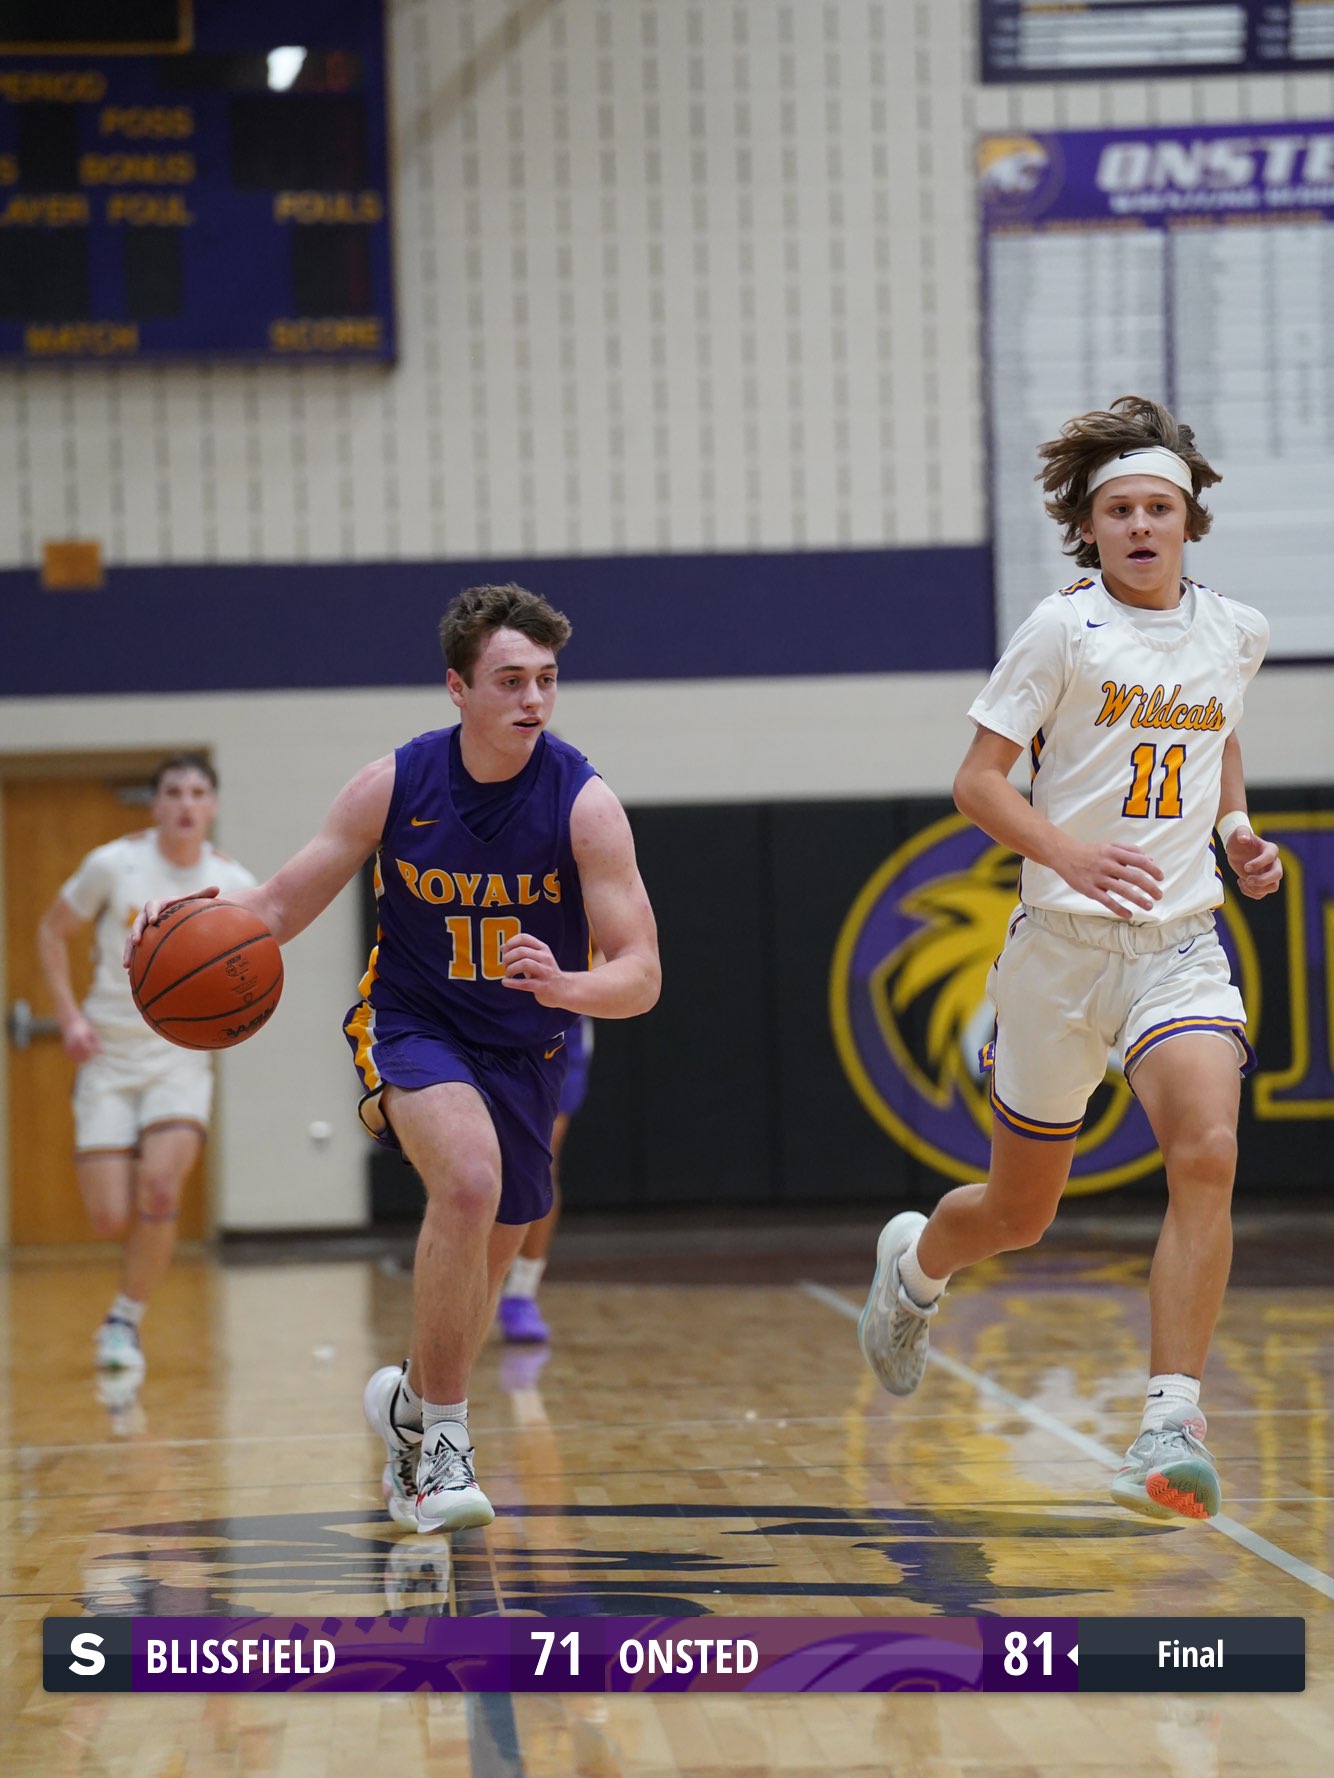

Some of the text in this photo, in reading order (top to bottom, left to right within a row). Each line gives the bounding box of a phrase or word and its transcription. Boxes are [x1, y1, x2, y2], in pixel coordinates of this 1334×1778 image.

[102, 107, 194, 138] POSS
[80, 153, 195, 185] BONUS
[107, 194, 194, 226] FOUL
[274, 191, 383, 224] FOULS
[270, 317, 382, 352] SCORE
[1094, 680, 1226, 731] Wildcats
[1121, 742, 1187, 819] 11
[395, 858, 562, 908] ROYALS
[445, 915, 522, 981] 10
